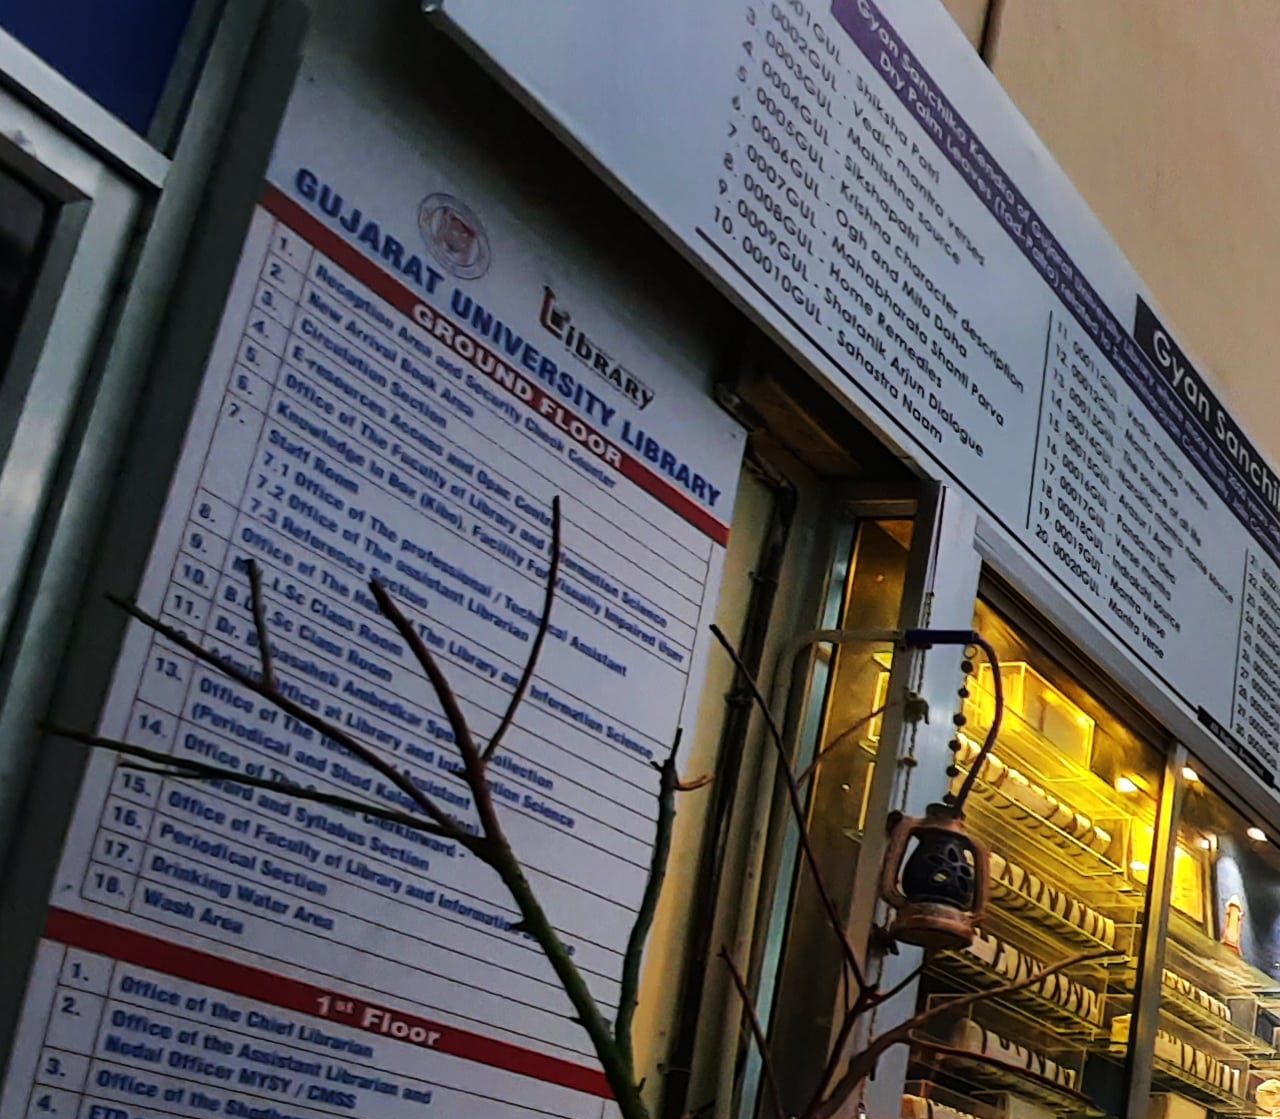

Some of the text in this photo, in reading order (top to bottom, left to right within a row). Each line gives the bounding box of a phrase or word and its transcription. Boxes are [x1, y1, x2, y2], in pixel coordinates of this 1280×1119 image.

[751, 114, 819, 199] 0006GUL
[835, 208, 867, 250] Ogh
[870, 249, 899, 283] and
[933, 313, 967, 358] Doha
[839, 180, 891, 245] Krishna
[894, 245, 958, 318] character
[960, 318, 1023, 392] description
[295, 169, 719, 505] GUJARAT UNIVERSITY LIBRARY
[413, 304, 621, 467] GROUND FLOOR
[714, 205, 942, 443] 10. 00010GUL Sahastra Naam
[1153, 330, 1209, 420] Gyan
[104, 839, 333, 930] 17. Drinking Water Area
[71, 962, 372, 1057] 1. Office of the Chief Librarian
[316, 995, 439, 1045] 1st Floor
